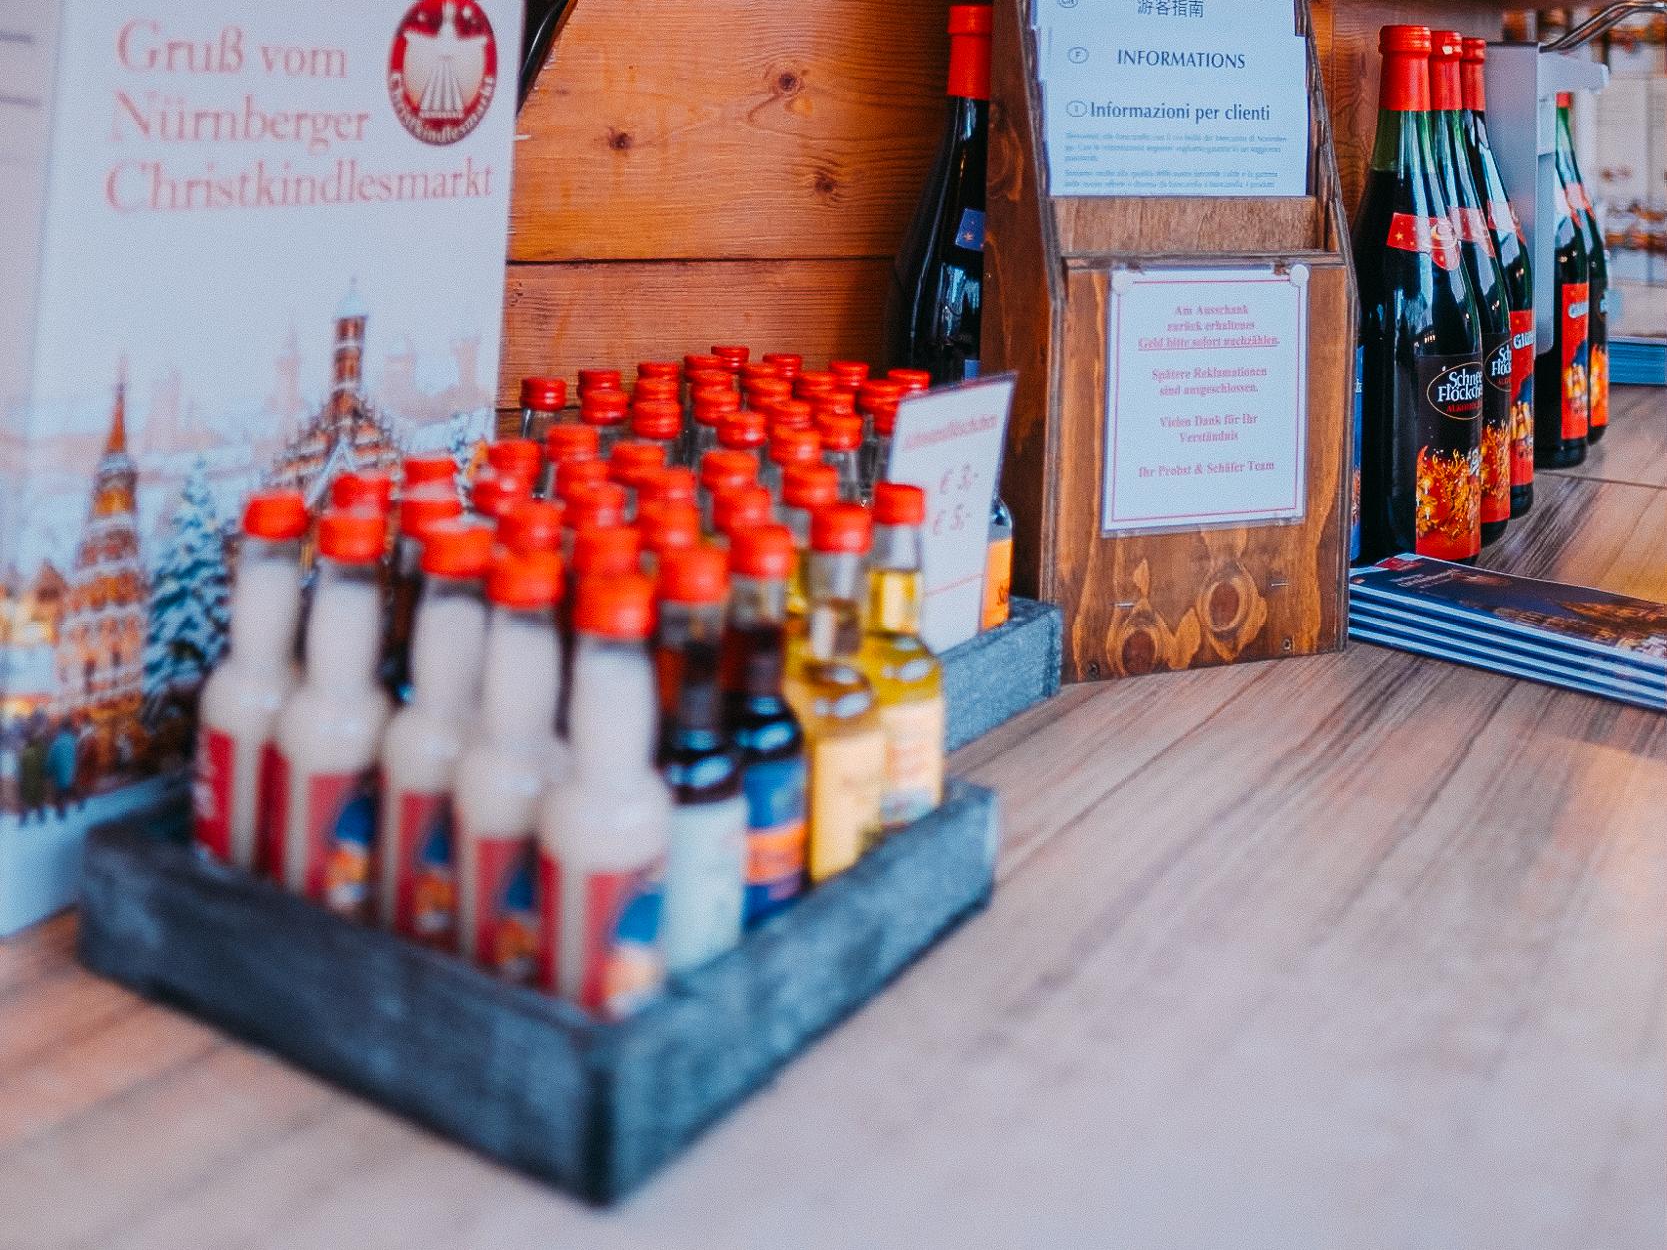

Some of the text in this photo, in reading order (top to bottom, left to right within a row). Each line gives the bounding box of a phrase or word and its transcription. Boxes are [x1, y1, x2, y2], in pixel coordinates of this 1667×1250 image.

[115, 16, 348, 80] Gruß vom
[1116, 49, 1246, 69] INFORMATIONS
[107, 88, 371, 151] Nürnberger
[1090, 100, 1271, 124] Informazioni per clienti
[105, 156, 494, 214] Christkindlesmarkt
[1175, 305, 1193, 316] Am
[1192, 336, 1221, 349] sofort
[1152, 366, 1267, 383] Spätere Reklamationen
[1160, 386, 1181, 396] sind
[1160, 417, 1191, 428] Vielen
[1195, 415, 1221, 426] Dank
[1224, 414, 1240, 425] für
[1159, 465, 1191, 477] Probst
[1194, 464, 1203, 475] &
[1207, 461, 1245, 474] Schäfer
[1248, 460, 1275, 471] Team
